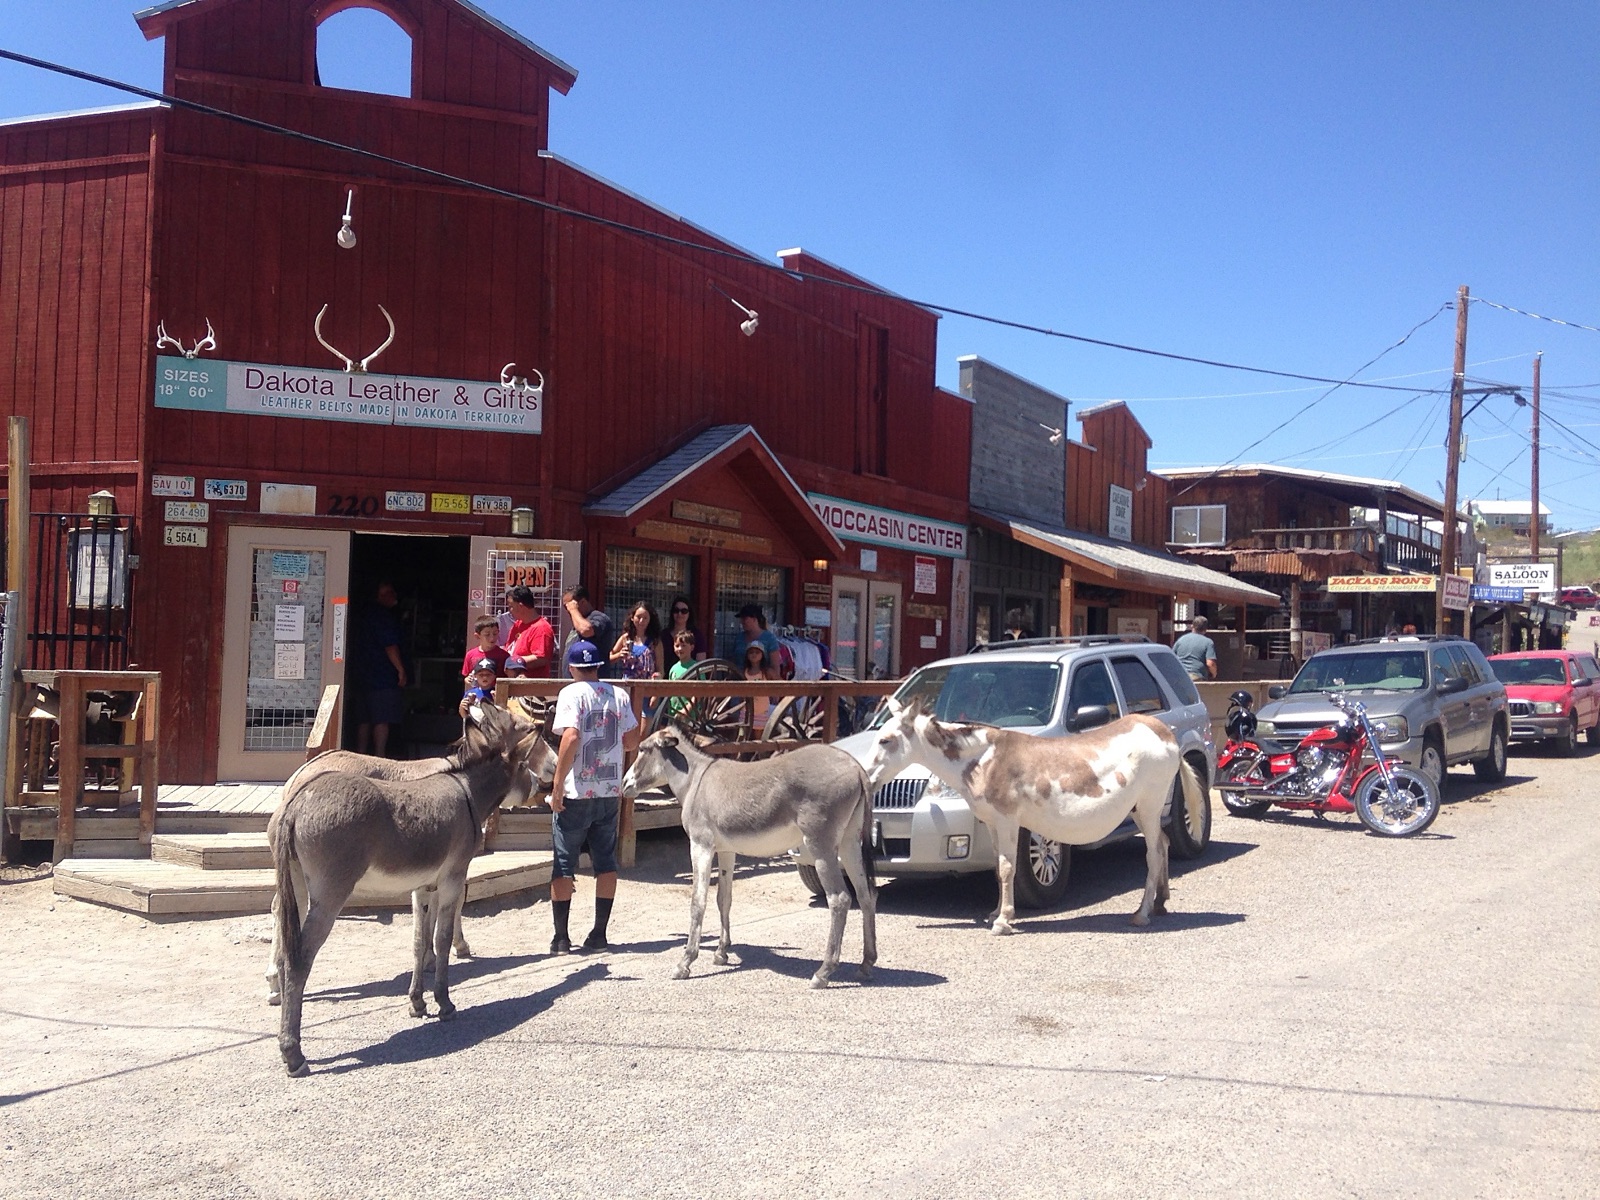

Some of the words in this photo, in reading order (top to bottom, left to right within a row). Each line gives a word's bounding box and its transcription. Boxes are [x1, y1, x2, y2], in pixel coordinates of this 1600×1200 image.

[164, 369, 209, 384] SIZES
[245, 368, 335, 396] Dakota
[349, 377, 440, 404] Leather
[453, 385, 469, 406] &
[483, 387, 538, 411] Gifts
[261, 395, 312, 410] LEATHER
[319, 400, 353, 413] BELTS
[359, 403, 390, 416] MADE
[397, 406, 409, 417] IN
[415, 407, 458, 420] DAKOTA
[464, 410, 526, 425] TERRITORY
[153, 479, 172, 489] 5AV
[223, 484, 245, 495] 6370
[327, 494, 379, 517] 220
[387, 496, 404, 507] 6NC
[406, 496, 424, 507] 802
[814, 503, 904, 539] MOCCASIN
[907, 523, 963, 550] CENTER
[175, 531, 197, 543] 5641
[506, 565, 546, 588] OPEN
[1330, 577, 1388, 586] JACKASS
[1388, 576, 1432, 585] RON'S
[1494, 570, 1549, 580] SALOON
[582, 709, 618, 781] 2
